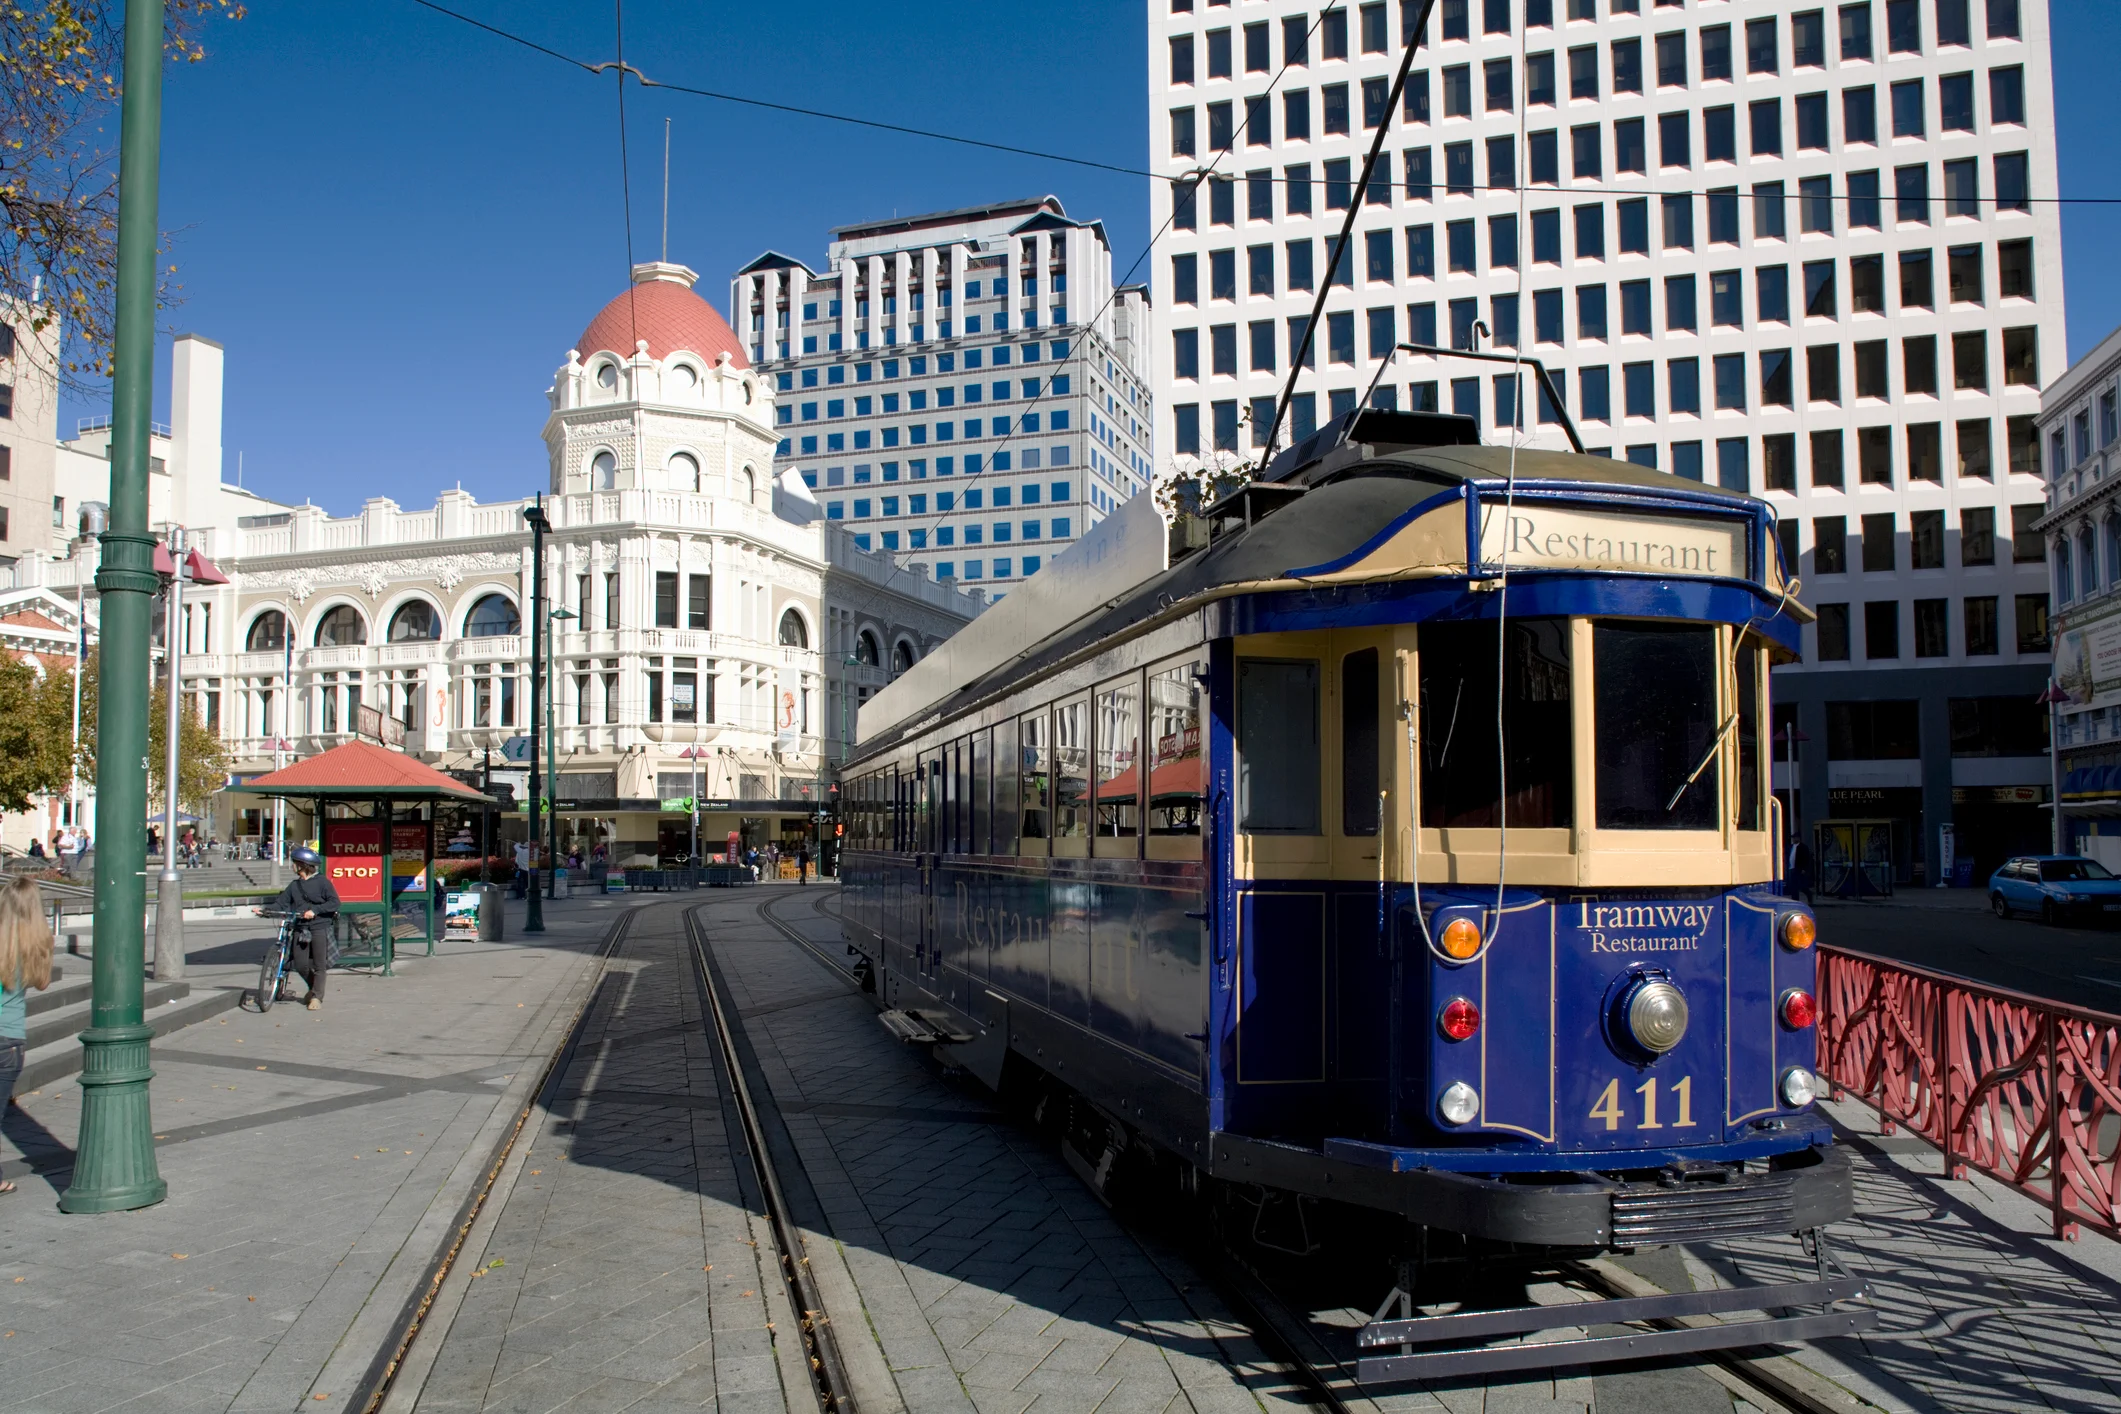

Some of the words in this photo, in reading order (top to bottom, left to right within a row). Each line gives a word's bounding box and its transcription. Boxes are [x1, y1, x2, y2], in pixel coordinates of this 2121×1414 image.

[1508, 516, 1718, 573] Restaurant
[361, 709, 380, 736] TRAM
[1849, 790, 1885, 800] PEARL
[332, 843, 380, 854] TRAM
[332, 867, 379, 878] STOP
[1569, 893, 1715, 937] Tramway
[955, 880, 1140, 1002] Restaurant
[1590, 931, 1699, 954] Restaurant
[1588, 1075, 1698, 1131] 411
